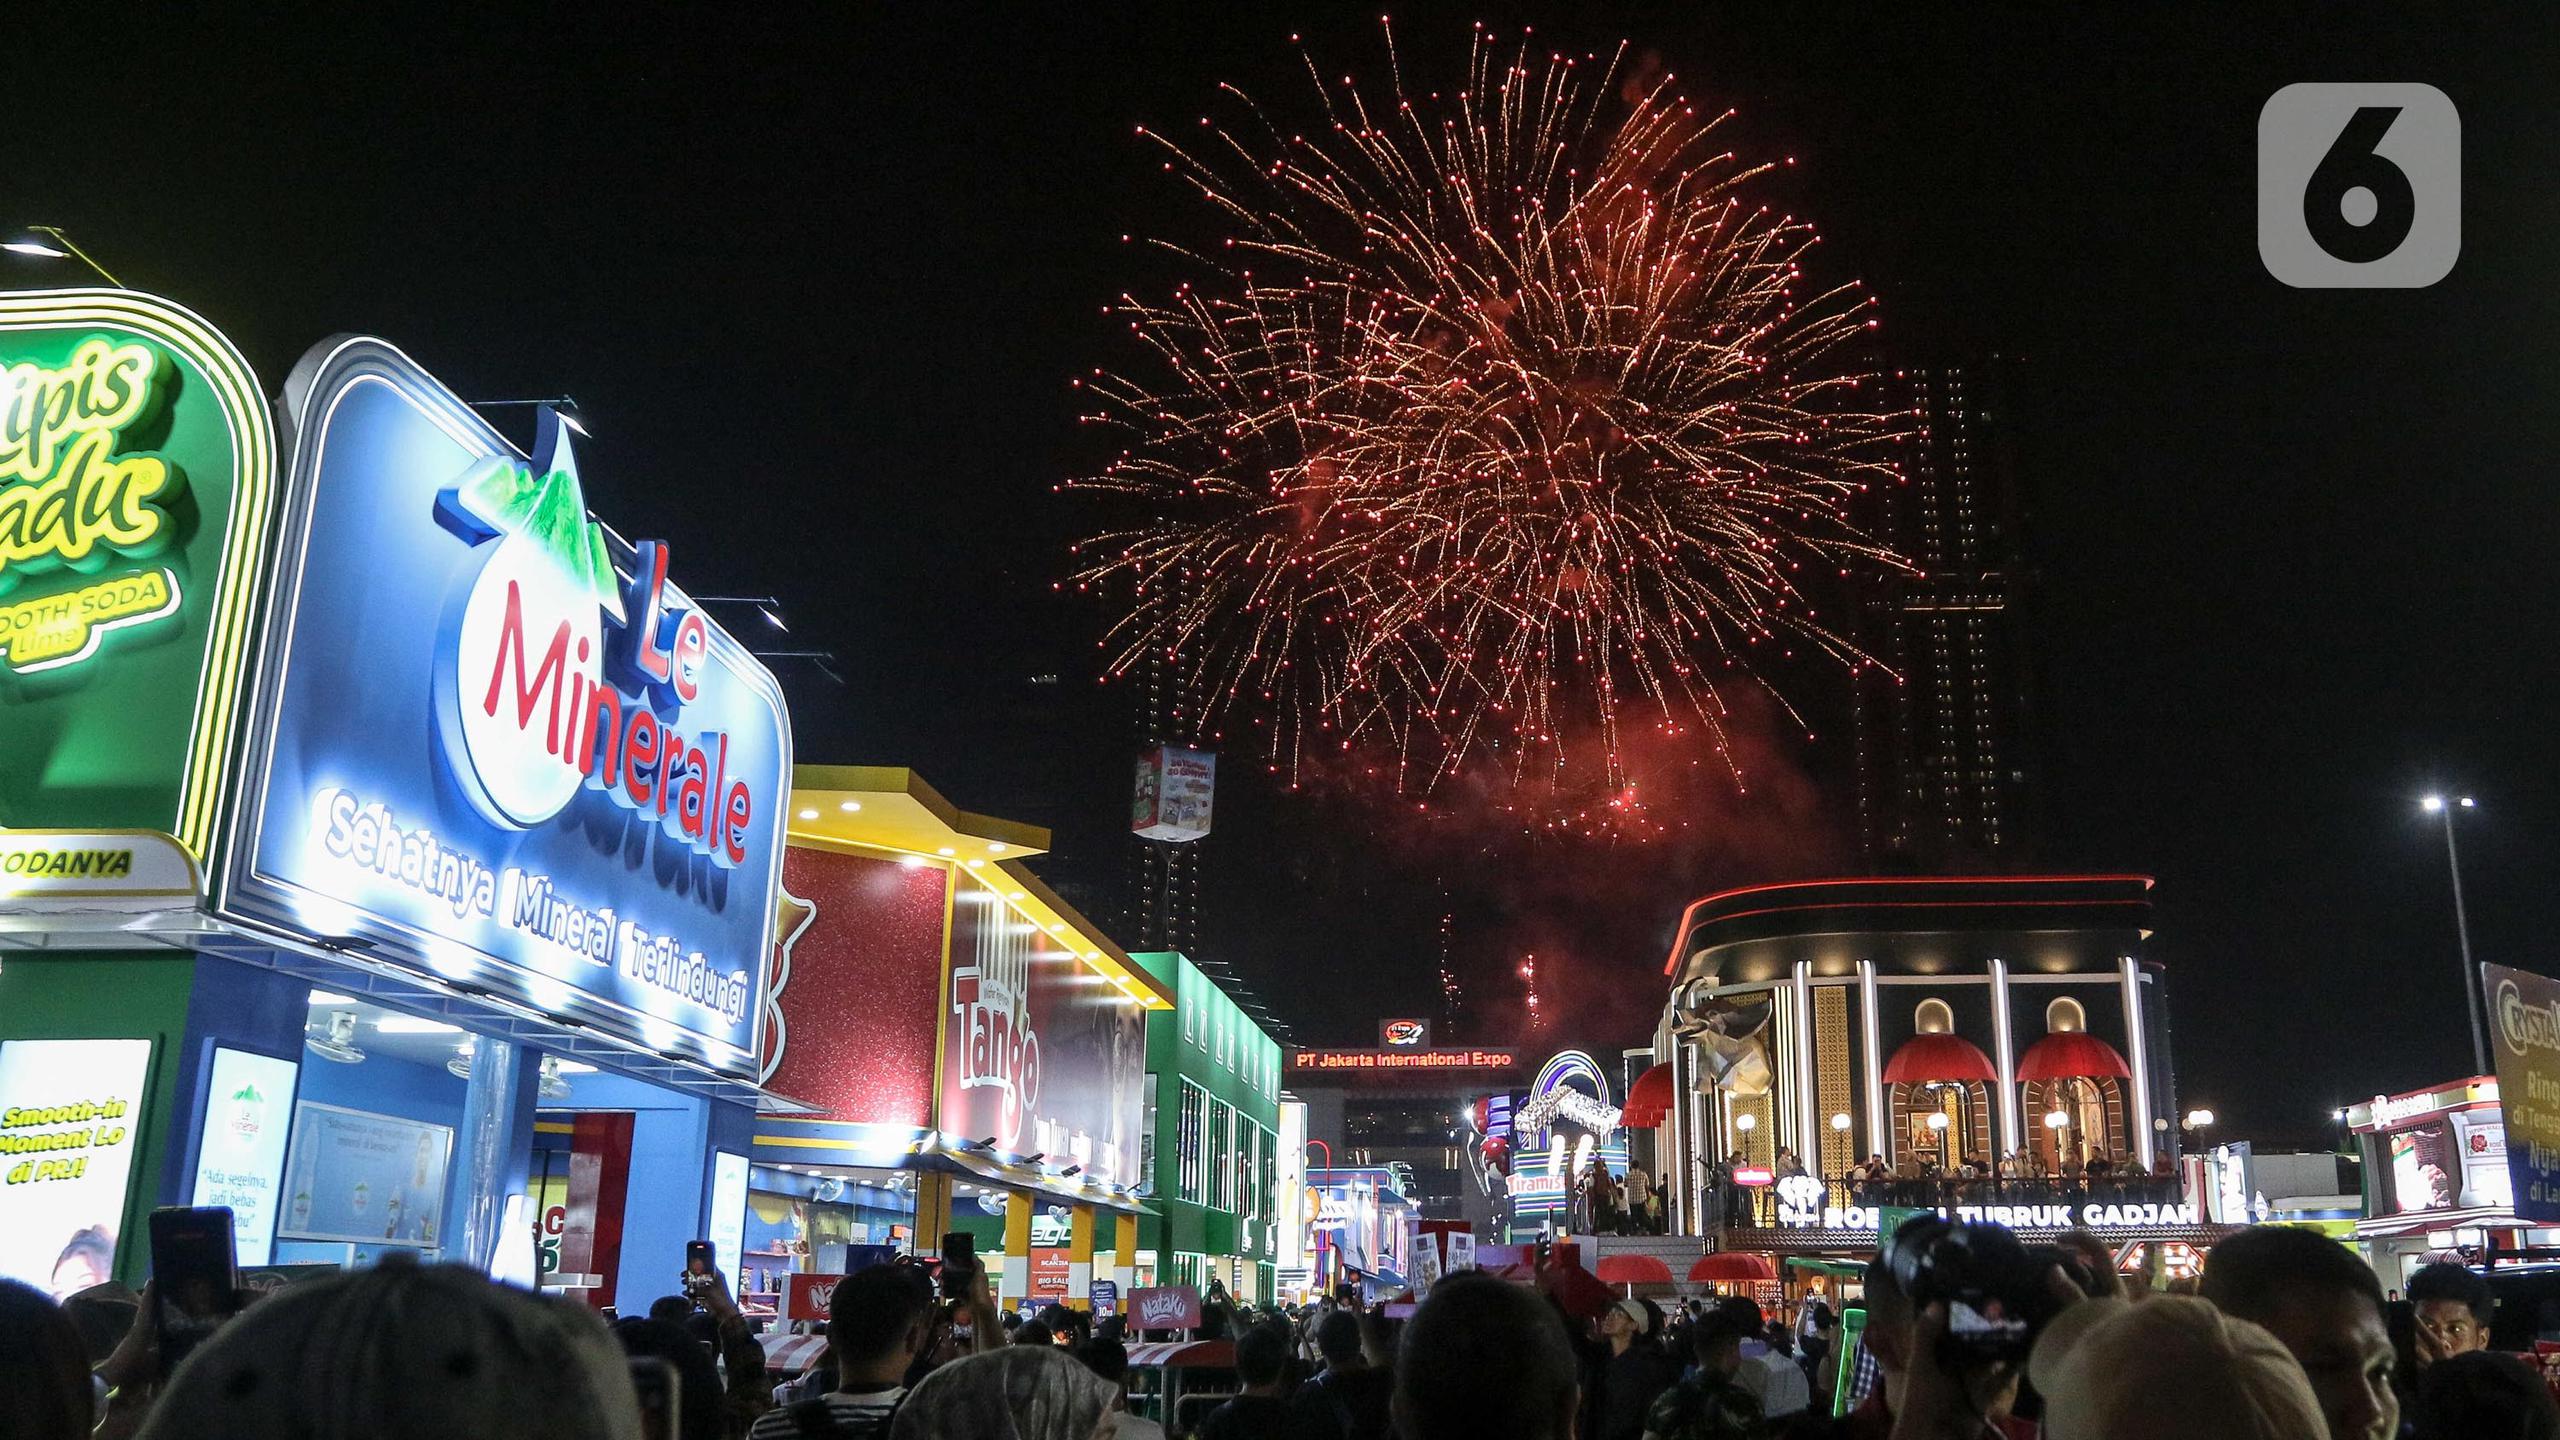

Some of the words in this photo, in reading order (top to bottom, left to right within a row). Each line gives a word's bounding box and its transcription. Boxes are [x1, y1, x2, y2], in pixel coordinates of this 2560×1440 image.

[0, 354, 138, 467] ipis
[80, 581, 158, 614] SODA
[638, 540, 707, 701] Le
[484, 579, 752, 864] Minerale
[0, 851, 131, 873] ODANYA
[325, 794, 496, 919] Sehatnya
[513, 874, 617, 963] Mineral
[631, 928, 749, 1023] Terlindungi
[955, 967, 1039, 1147] Tango
[1297, 1053, 1316, 1067] PT
[1319, 1053, 1374, 1067] Jakarta
[1377, 1052, 1469, 1067] International
[1473, 1052, 1512, 1068] Expo
[1, 1095, 128, 1129] Smooth-in
[2513, 1105, 2525, 1125] di
[7, 1160, 35, 1185] di
[34, 1156, 89, 1183] PRJ!
[2530, 1180, 2542, 1201] di
[233, 1211, 256, 1229] ebu”
[1957, 1205, 2072, 1227] TUBRUK
[2083, 1204, 2199, 1226] GADJAH
